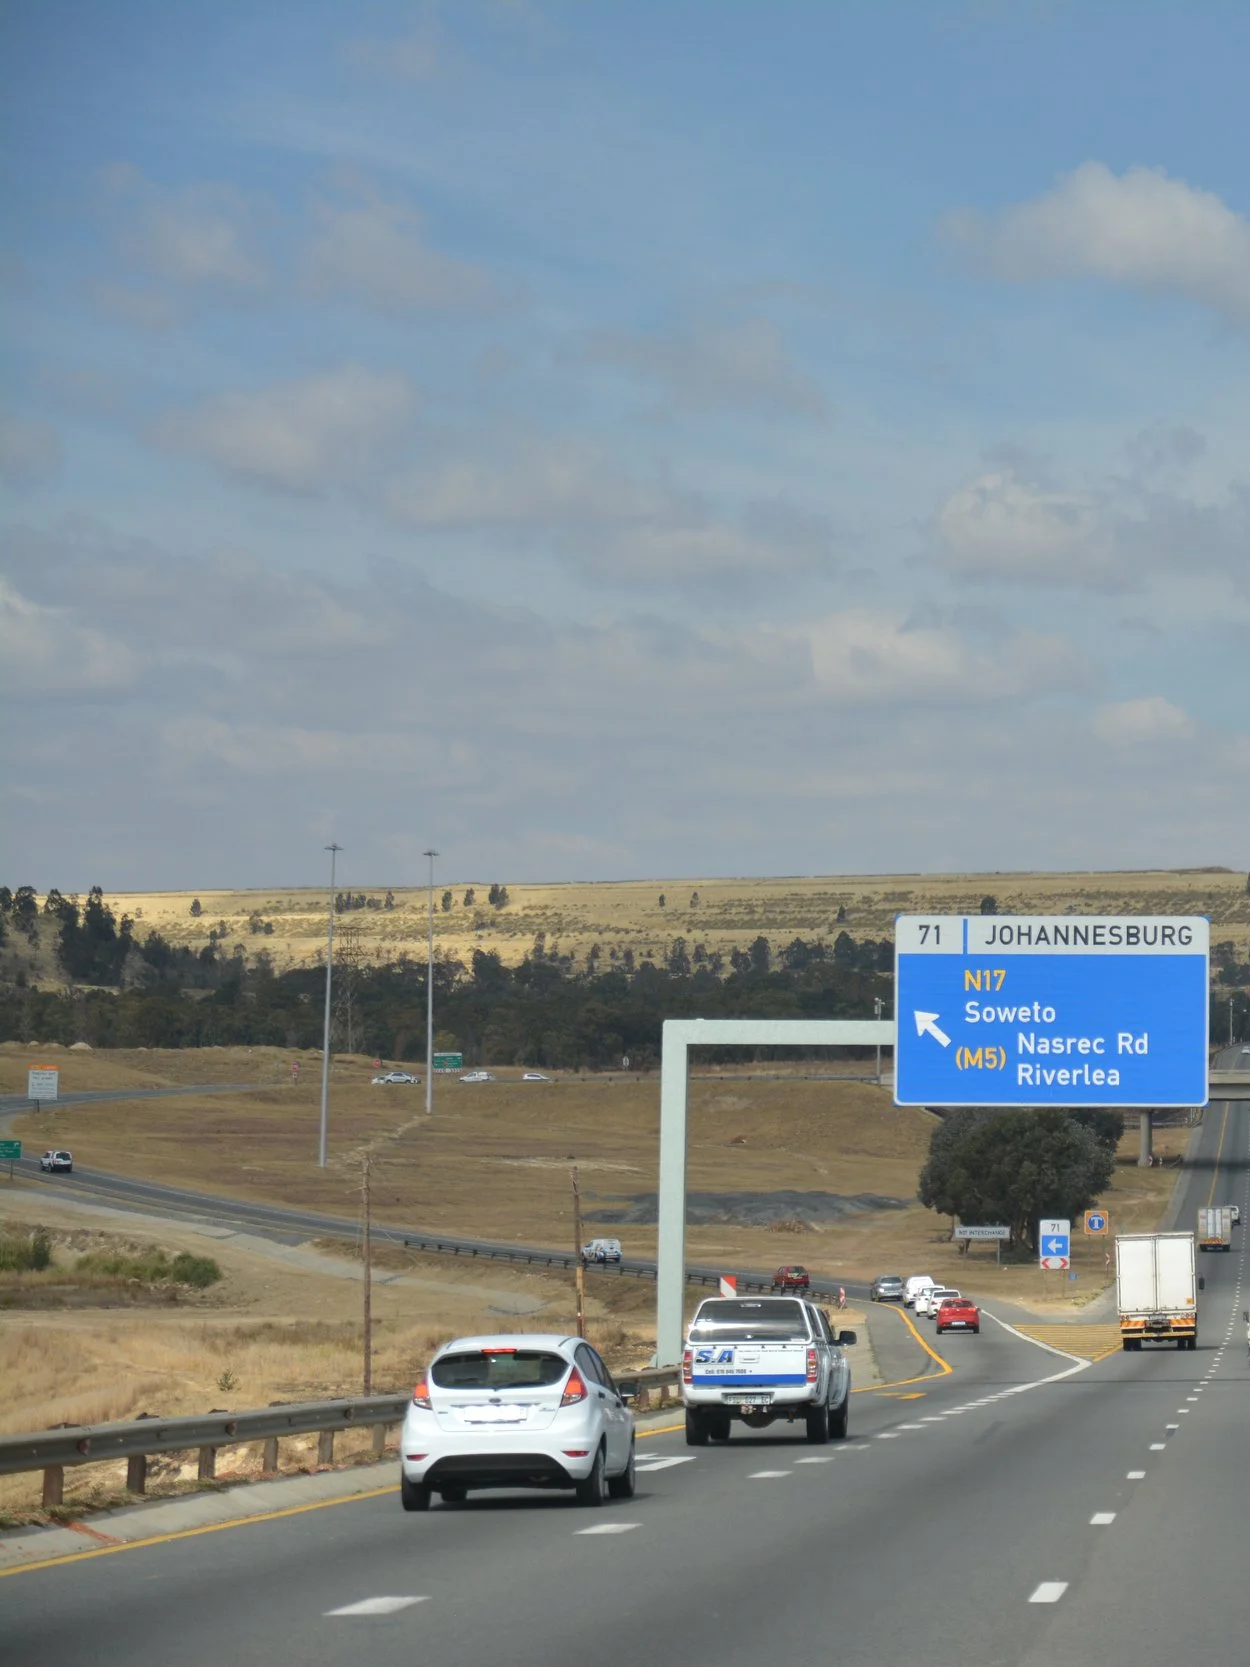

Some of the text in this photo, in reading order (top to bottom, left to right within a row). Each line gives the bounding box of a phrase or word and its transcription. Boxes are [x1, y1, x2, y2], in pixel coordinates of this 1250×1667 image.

[918, 925, 941, 945] 71
[985, 925, 1193, 946] JOHANNESBURG
[964, 969, 1006, 992] N17
[964, 1001, 1056, 1023] Soweto
[1017, 1032, 1149, 1054] Nasrec Rd
[955, 1046, 1007, 1071] (M5)
[1017, 1063, 1120, 1086] Riverlea
[1050, 1223, 1060, 1233] 71
